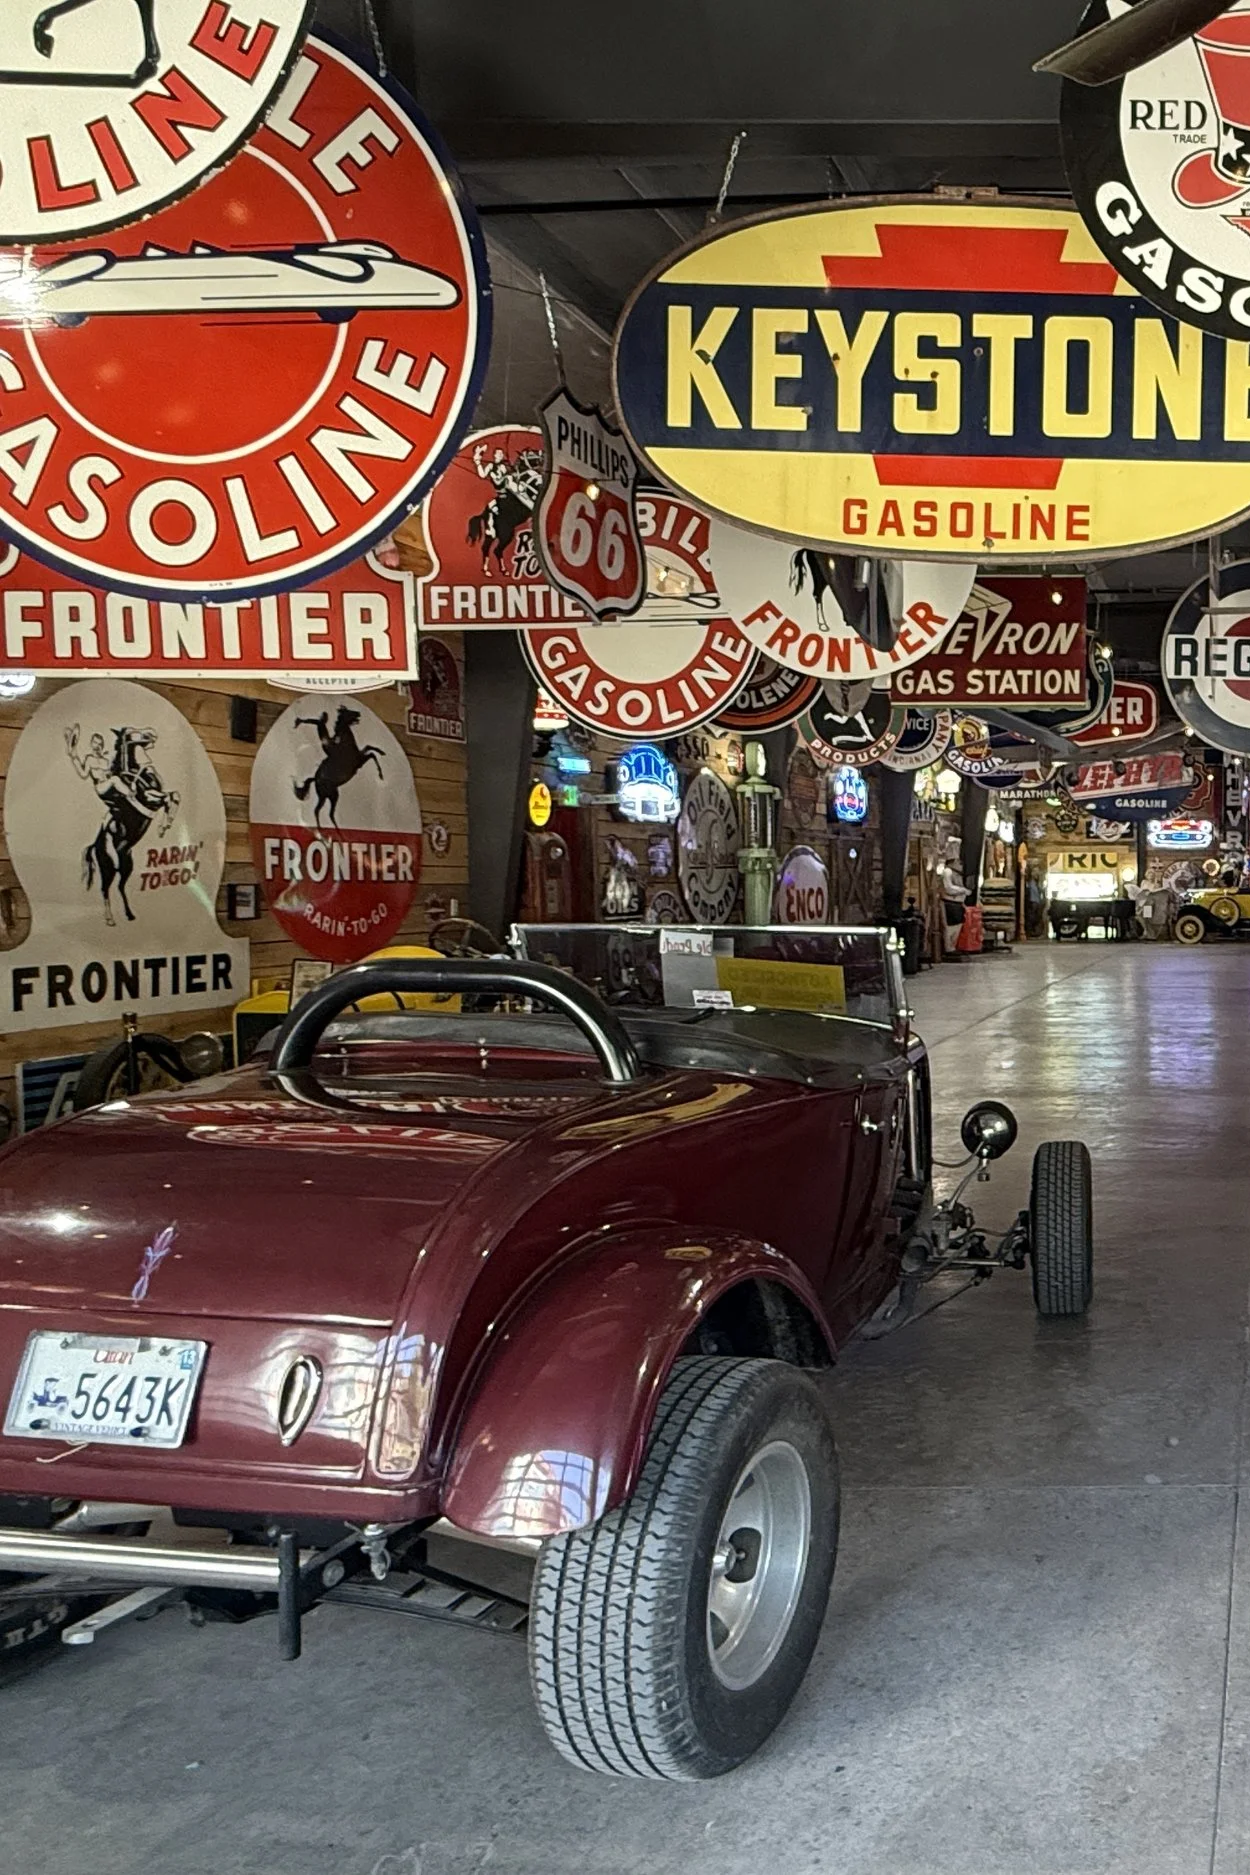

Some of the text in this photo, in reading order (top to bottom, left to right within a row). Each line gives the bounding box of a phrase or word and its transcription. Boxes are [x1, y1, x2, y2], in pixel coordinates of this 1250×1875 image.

[0, 0, 280, 213] LINE
[1128, 99, 1208, 131] RED
[1172, 133, 1208, 145] TRADE
[556, 415, 631, 490] PHILLIPS
[559, 490, 628, 582] 66
[842, 497, 1091, 542] GASOLINE
[430, 584, 592, 621] FRONTIE
[4, 590, 395, 662] FRONTIER
[540, 630, 748, 727] GASOLINE
[895, 669, 1081, 696] GAS STATION
[410, 712, 463, 738] FRONTIER
[810, 731, 897, 764] PRODUCTS
[1000, 789, 1058, 800] MARATHON
[1115, 797, 1168, 810] GASOLINE
[263, 836, 414, 882] FRONTIER
[785, 884, 825, 923] ENCO
[12, 952, 233, 1012] FRONTIER
[71, 1372, 186, 1427] 5643K
[54, 1422, 95, 1432] VINTAGE
